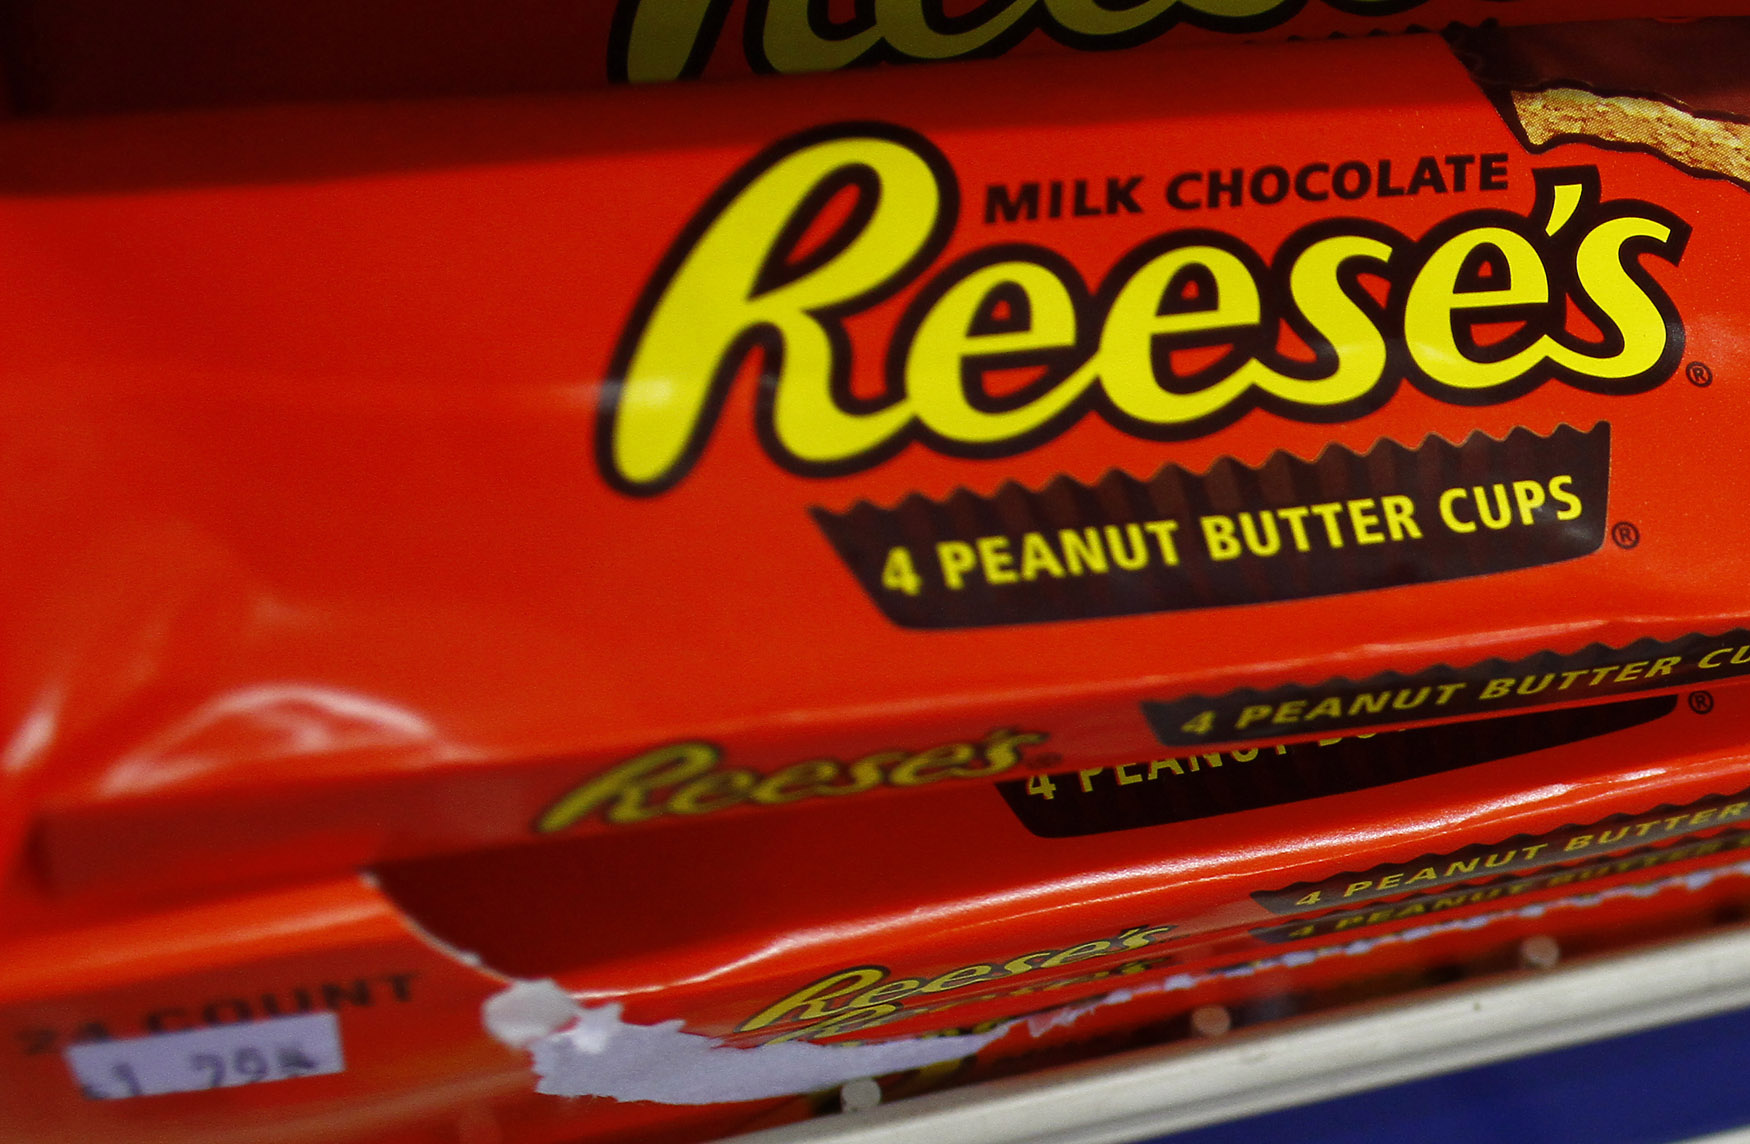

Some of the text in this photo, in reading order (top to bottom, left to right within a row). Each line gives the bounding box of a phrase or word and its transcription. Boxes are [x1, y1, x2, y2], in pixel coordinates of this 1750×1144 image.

[984, 153, 1509, 225] MILK CHOCOLATE
[596, 120, 1692, 497] Reese's
[882, 475, 1583, 595] 4 PEANUT BUTTER CUPS
[1180, 708, 1215, 735] 4
[1234, 683, 1467, 731] PEANUT
[1478, 655, 1683, 700] BUTTER
[532, 728, 1048, 835] Reese's
[1295, 889, 1322, 906] 4
[1343, 843, 1548, 898] PEANUT
[1564, 801, 1748, 852] BUTTER
[733, 923, 1177, 1034] Reese's
